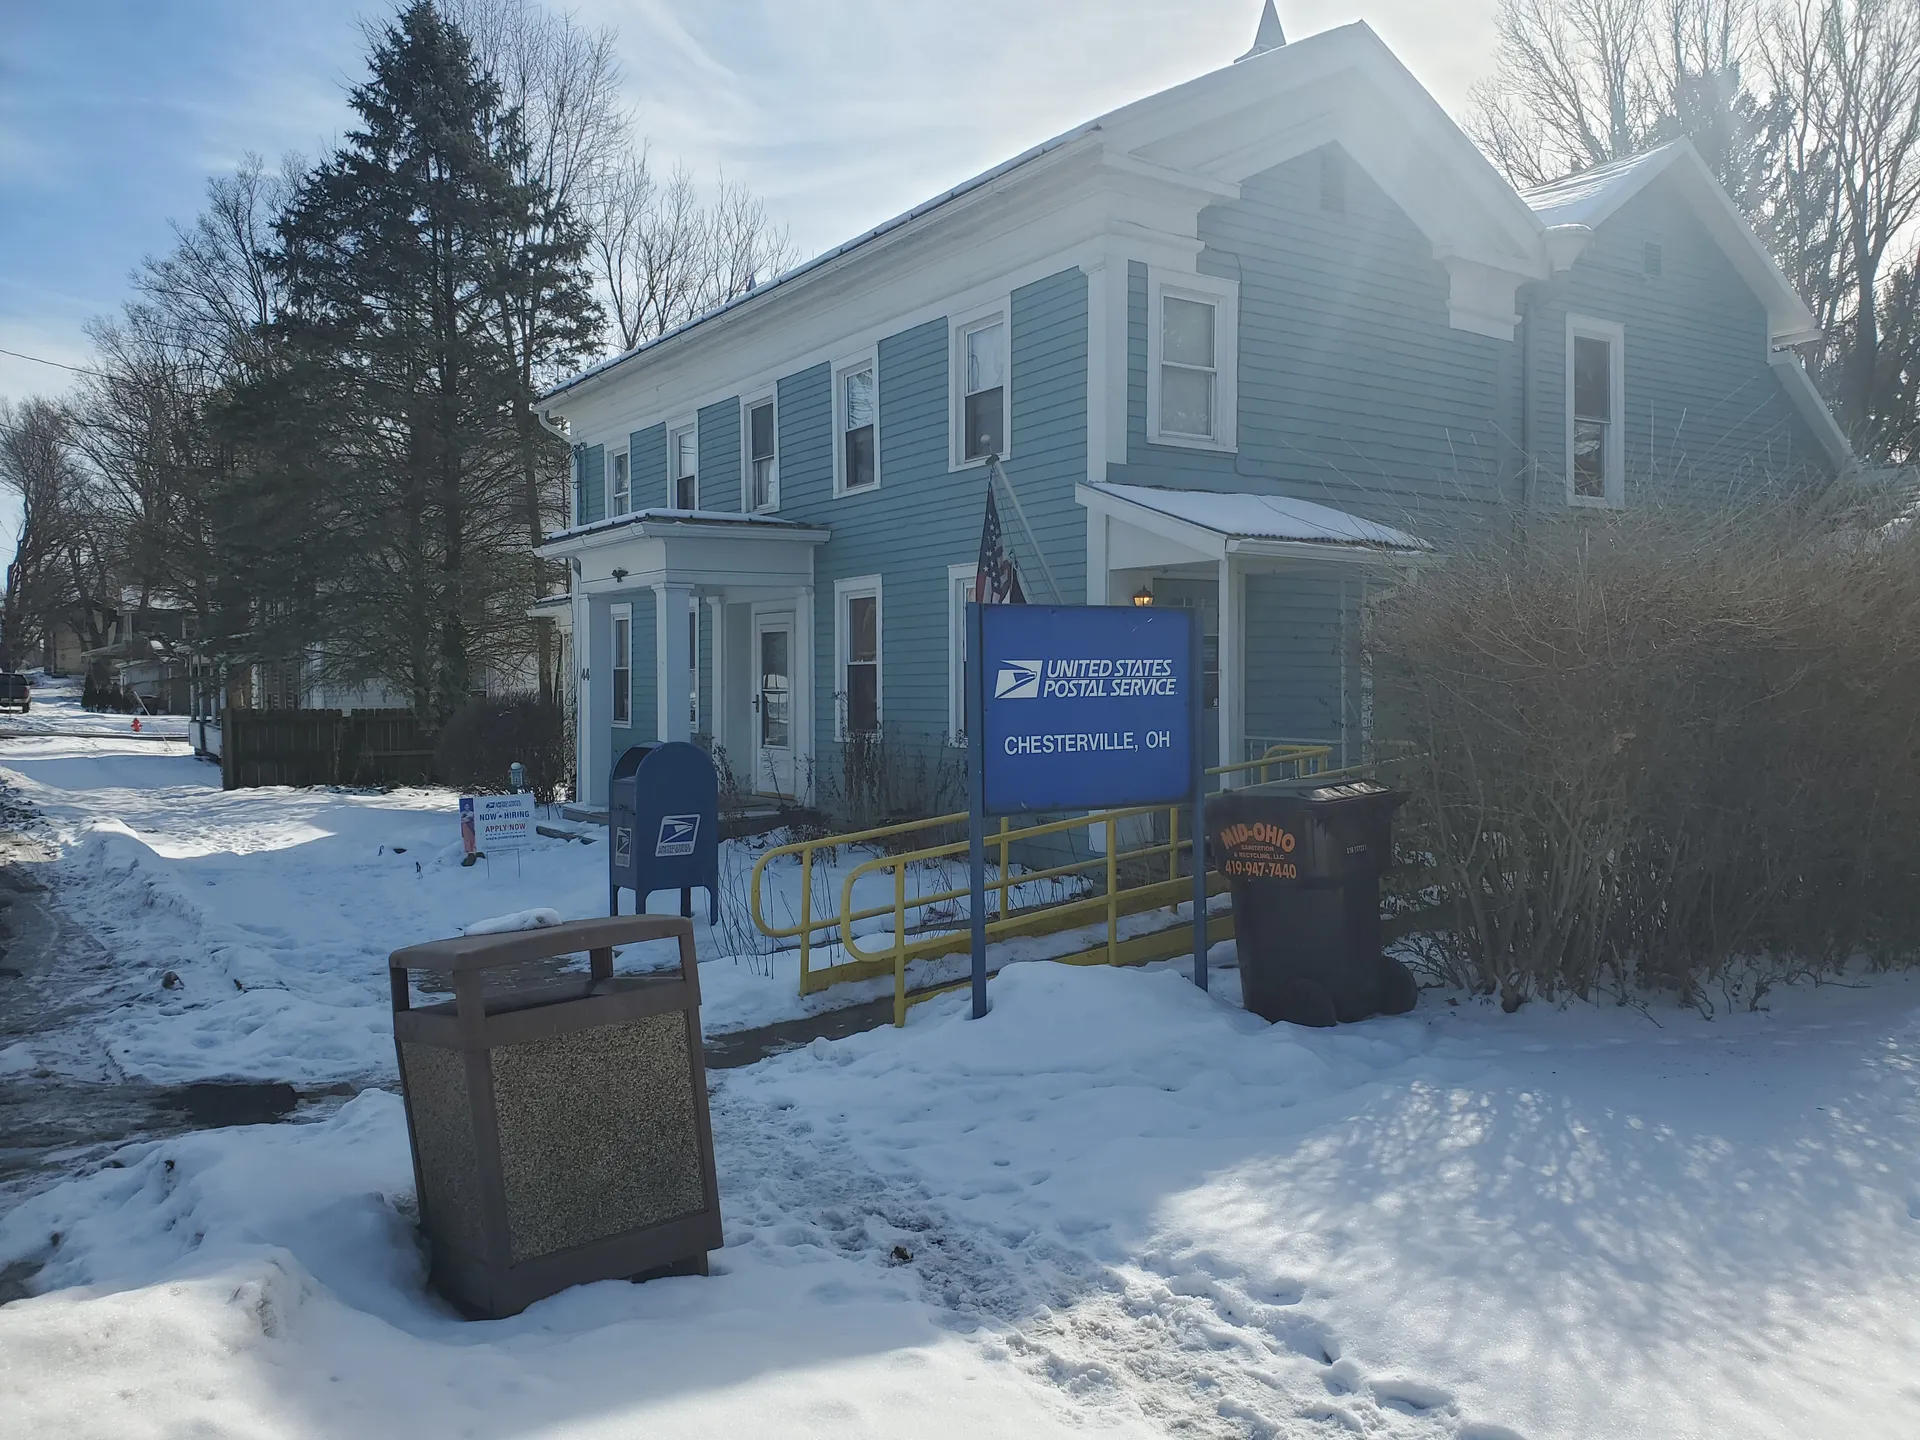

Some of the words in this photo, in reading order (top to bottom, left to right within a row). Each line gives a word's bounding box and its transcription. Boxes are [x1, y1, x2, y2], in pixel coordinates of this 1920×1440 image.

[581, 668, 590, 681] 44
[1047, 659, 1113, 678] UNITED
[1114, 659, 1172, 677] STATES
[1043, 679, 1107, 698] POSTAL
[1004, 731, 1139, 755] CHESTERVILLE,
[1145, 730, 1170, 749] OH
[480, 813, 497, 821] NOW
[504, 811, 530, 819] HIRING
[485, 824, 507, 833] APPLY
[510, 823, 526, 831] NOW
[1220, 822, 1296, 853] MID-OHIO
[1240, 844, 1275, 852] SANITATION
[1225, 860, 1297, 879] 419-947-7440
